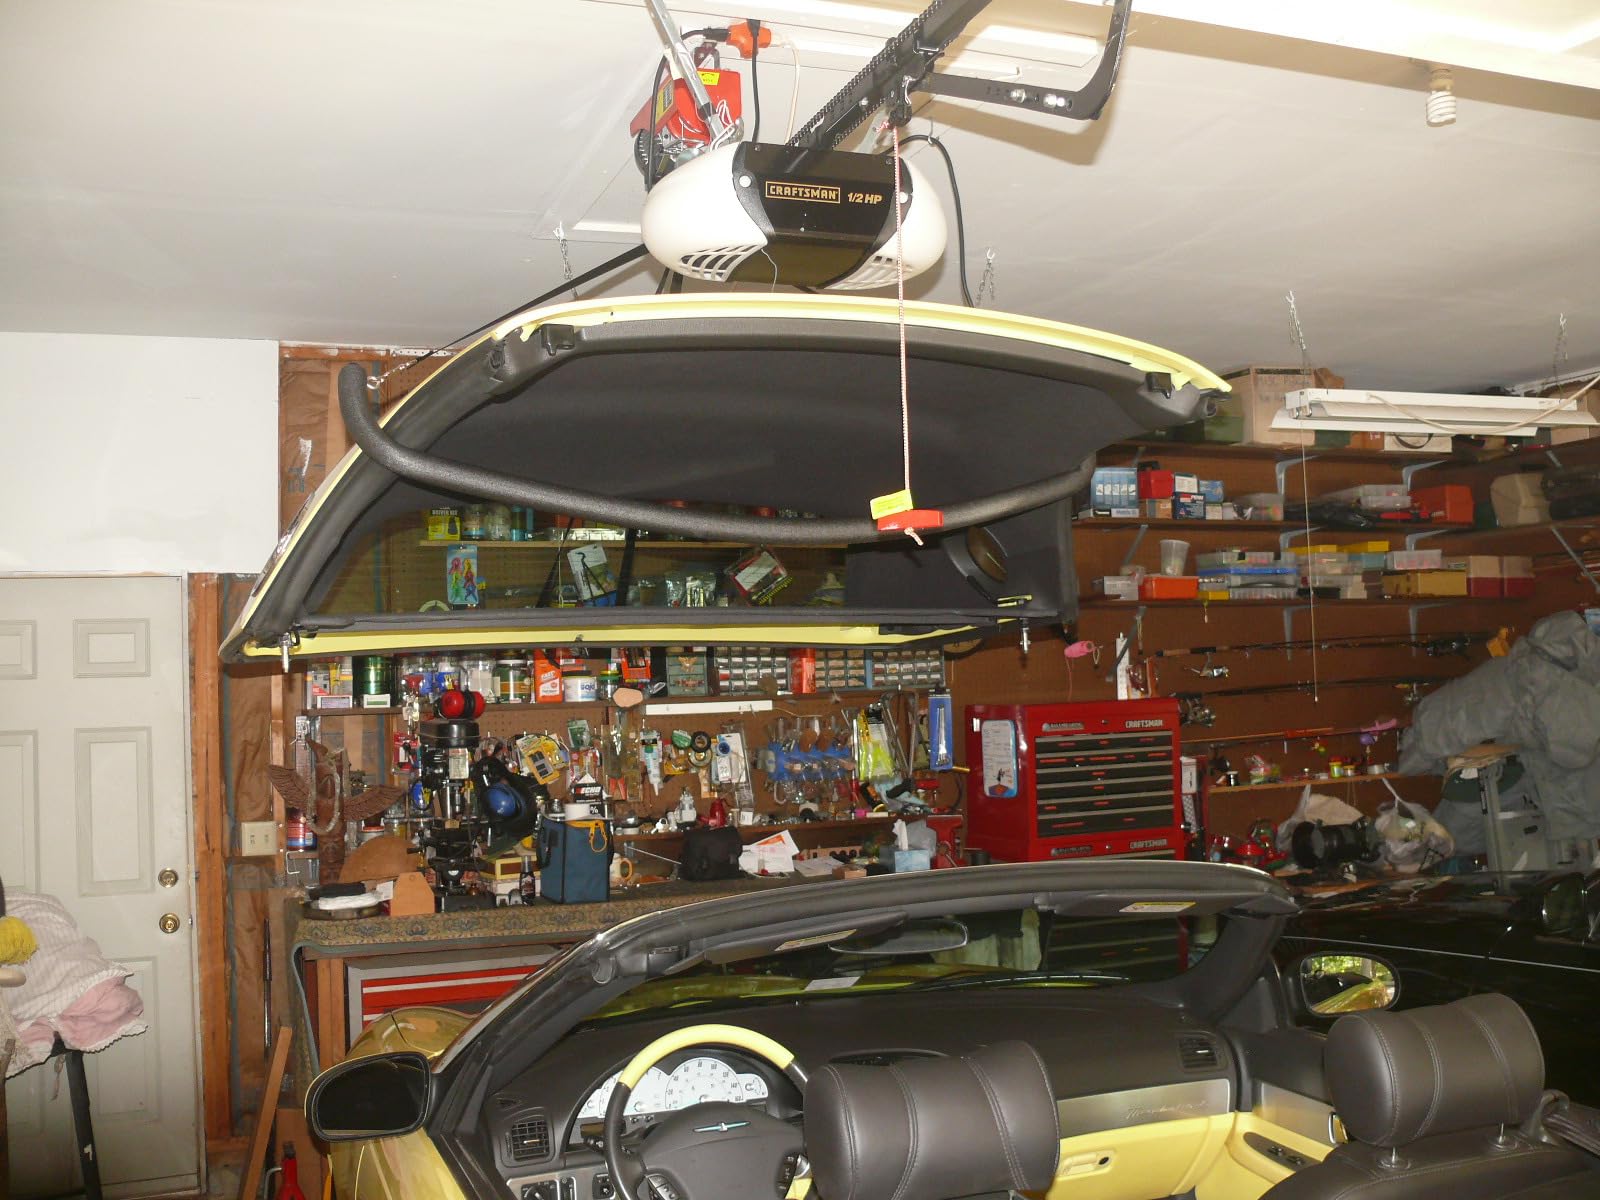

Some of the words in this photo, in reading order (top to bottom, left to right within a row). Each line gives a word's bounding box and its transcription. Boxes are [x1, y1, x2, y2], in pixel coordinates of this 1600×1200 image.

[769, 185, 838, 200] CRAFTSMAN
[847, 193, 863, 202] 1/2
[864, 193, 883, 204] HP
[1125, 719, 1164, 729] CRAFTSMAN
